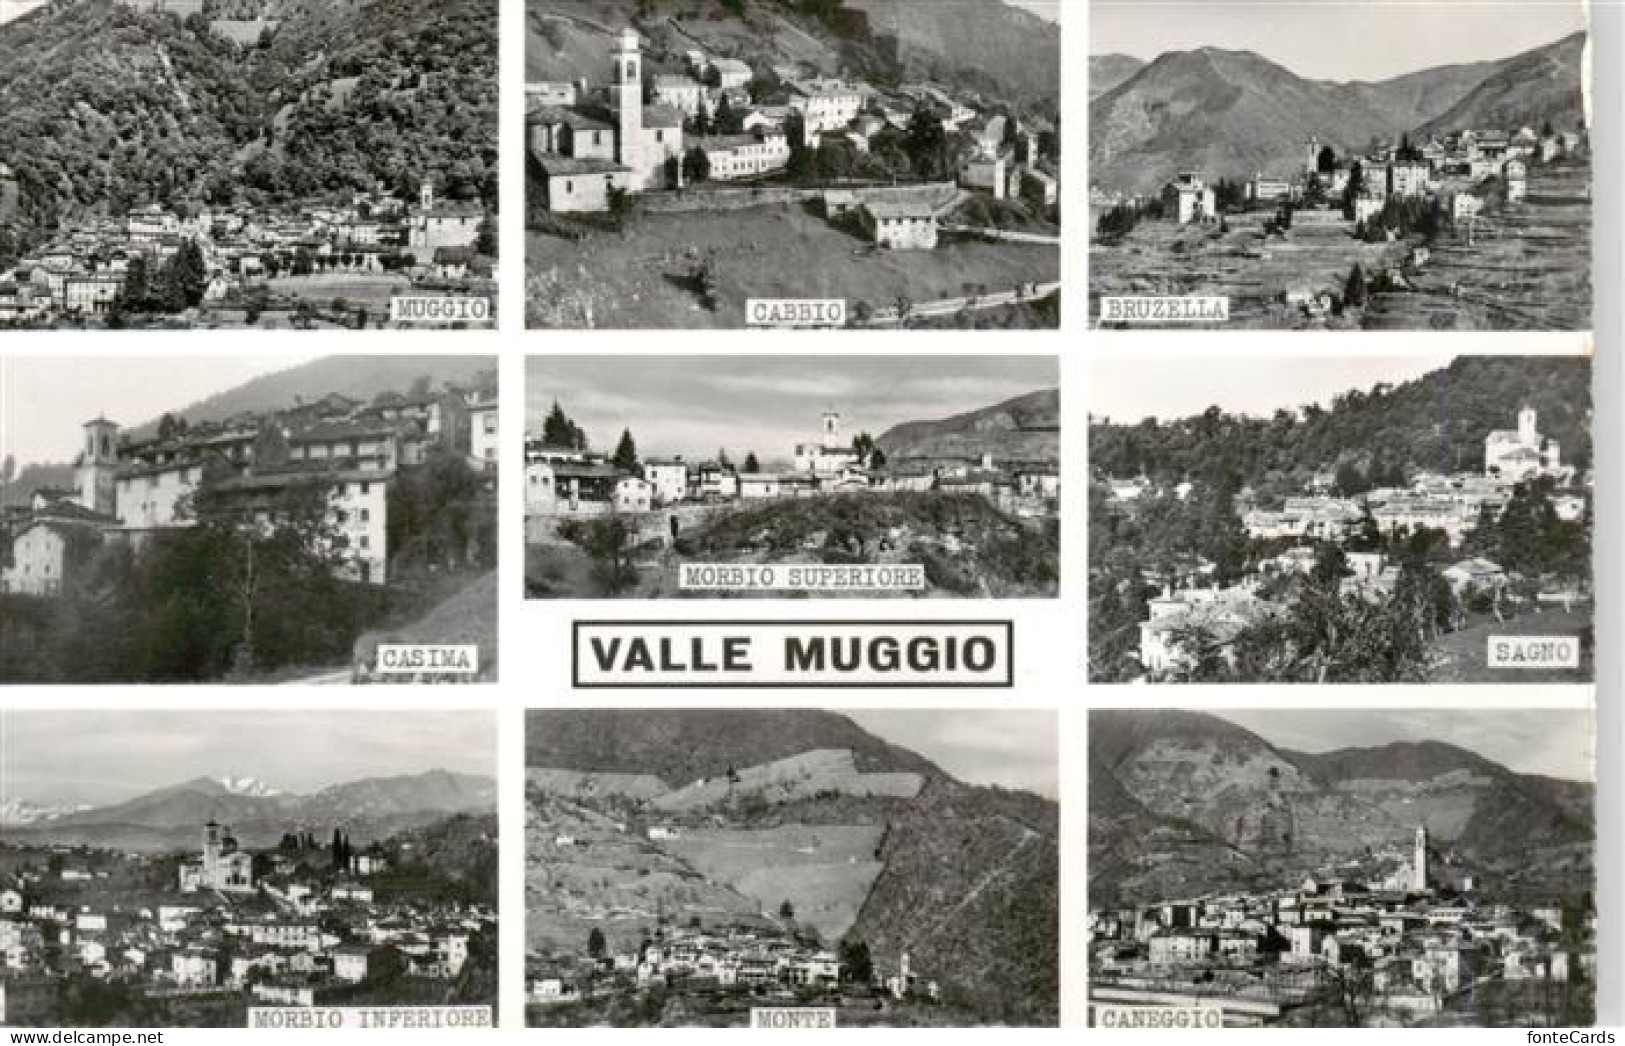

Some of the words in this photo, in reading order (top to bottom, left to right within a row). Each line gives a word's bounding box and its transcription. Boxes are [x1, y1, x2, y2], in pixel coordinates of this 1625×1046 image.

[398, 299, 486, 319] MUGGIO
[754, 303, 841, 321] CABBIO
[1107, 299, 1225, 319] BRUZELLA
[686, 567, 774, 586] MORBIO
[788, 567, 922, 586] SUPERIORE
[383, 649, 470, 669] CASIMA
[590, 636, 753, 672] VALLE
[784, 636, 997, 672] MUGGIO
[1495, 642, 1573, 662] SAGNO
[254, 1010, 343, 1028] MORBIO
[359, 1009, 489, 1028] INFERIORE
[758, 1011, 832, 1028] MONTE
[1103, 1009, 1221, 1028] CANEGGIO
